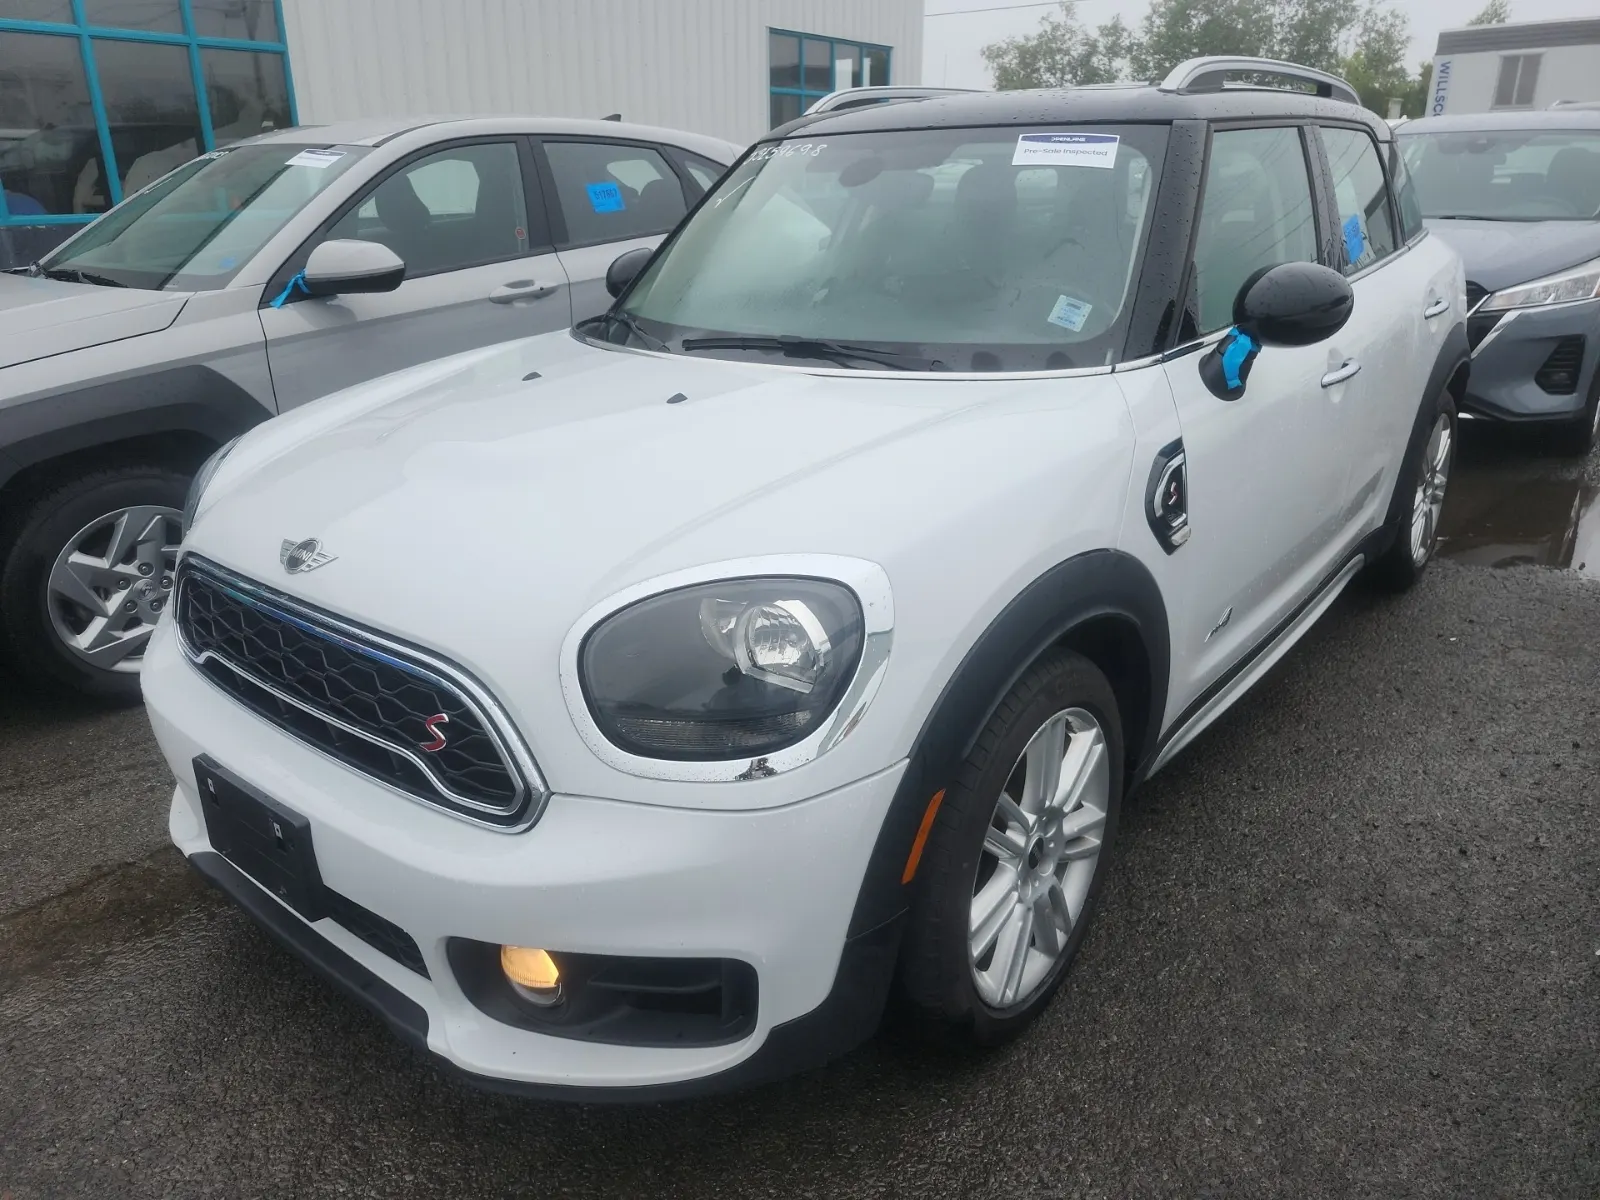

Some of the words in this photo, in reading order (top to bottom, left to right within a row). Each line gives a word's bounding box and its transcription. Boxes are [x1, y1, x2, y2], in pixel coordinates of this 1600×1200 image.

[1063, 148, 1108, 156] Inspected
[292, 548, 313, 561] MINI
[419, 713, 449, 752] S
